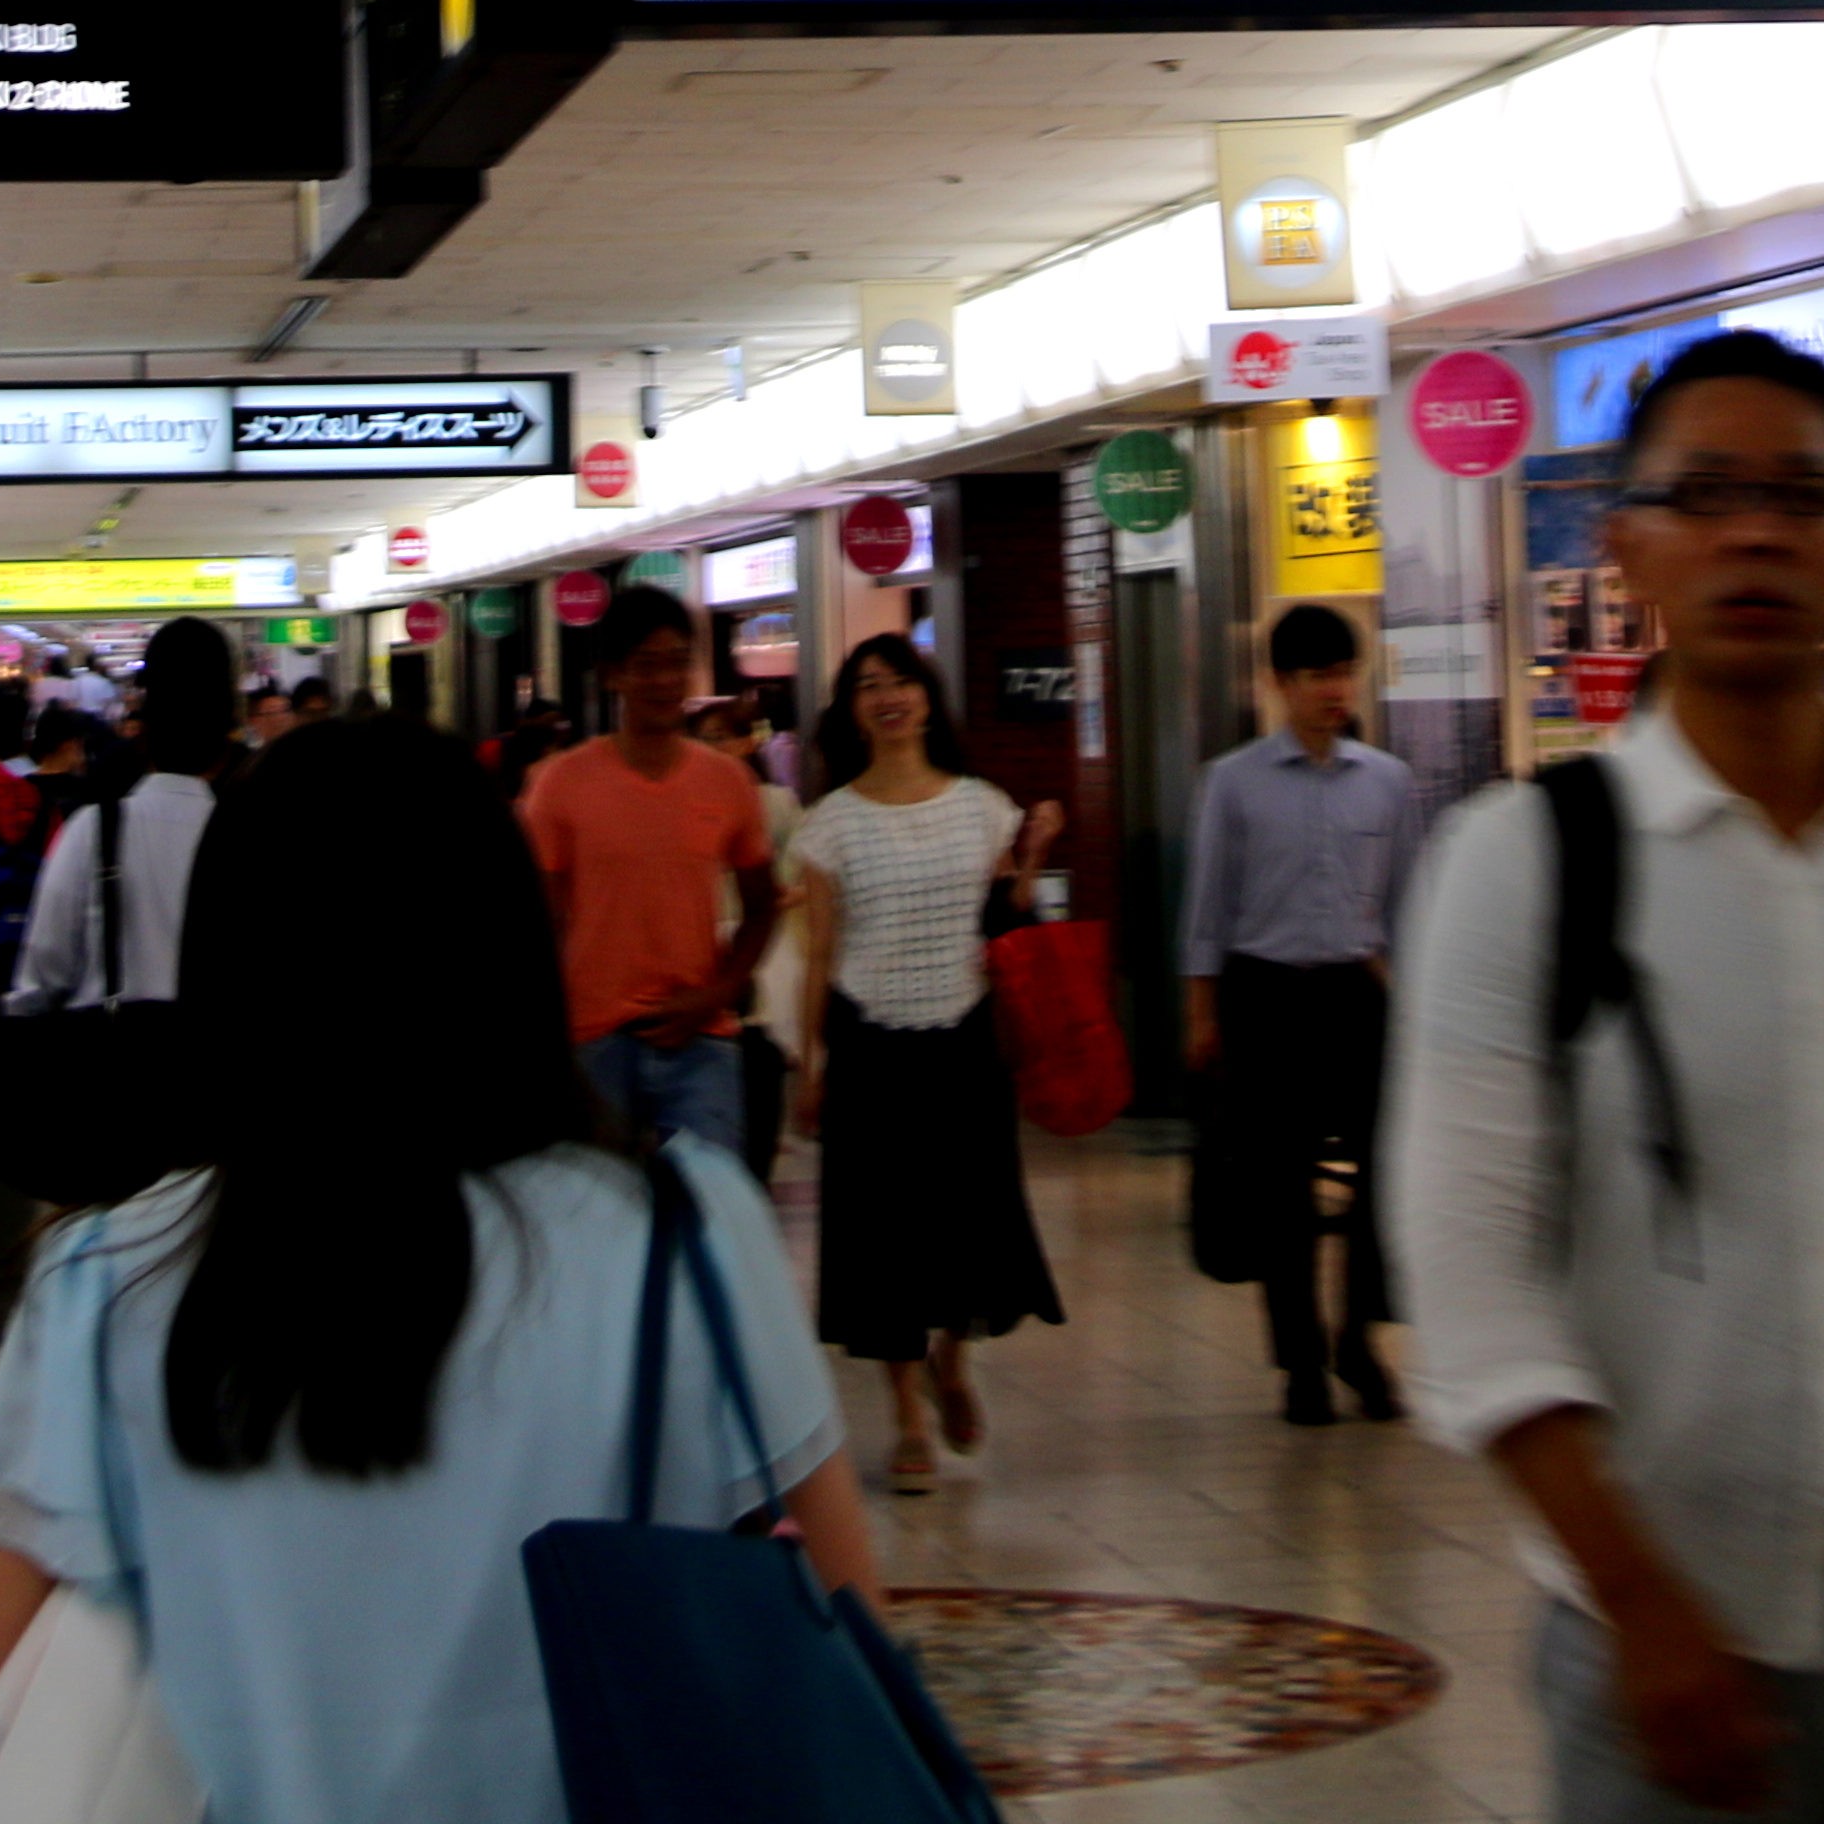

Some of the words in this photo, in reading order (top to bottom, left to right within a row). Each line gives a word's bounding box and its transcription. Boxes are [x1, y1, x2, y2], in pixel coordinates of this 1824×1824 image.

[1421, 398, 1519, 429] SALE
[1103, 468, 1183, 496] SALE
[846, 525, 908, 545] SALE
